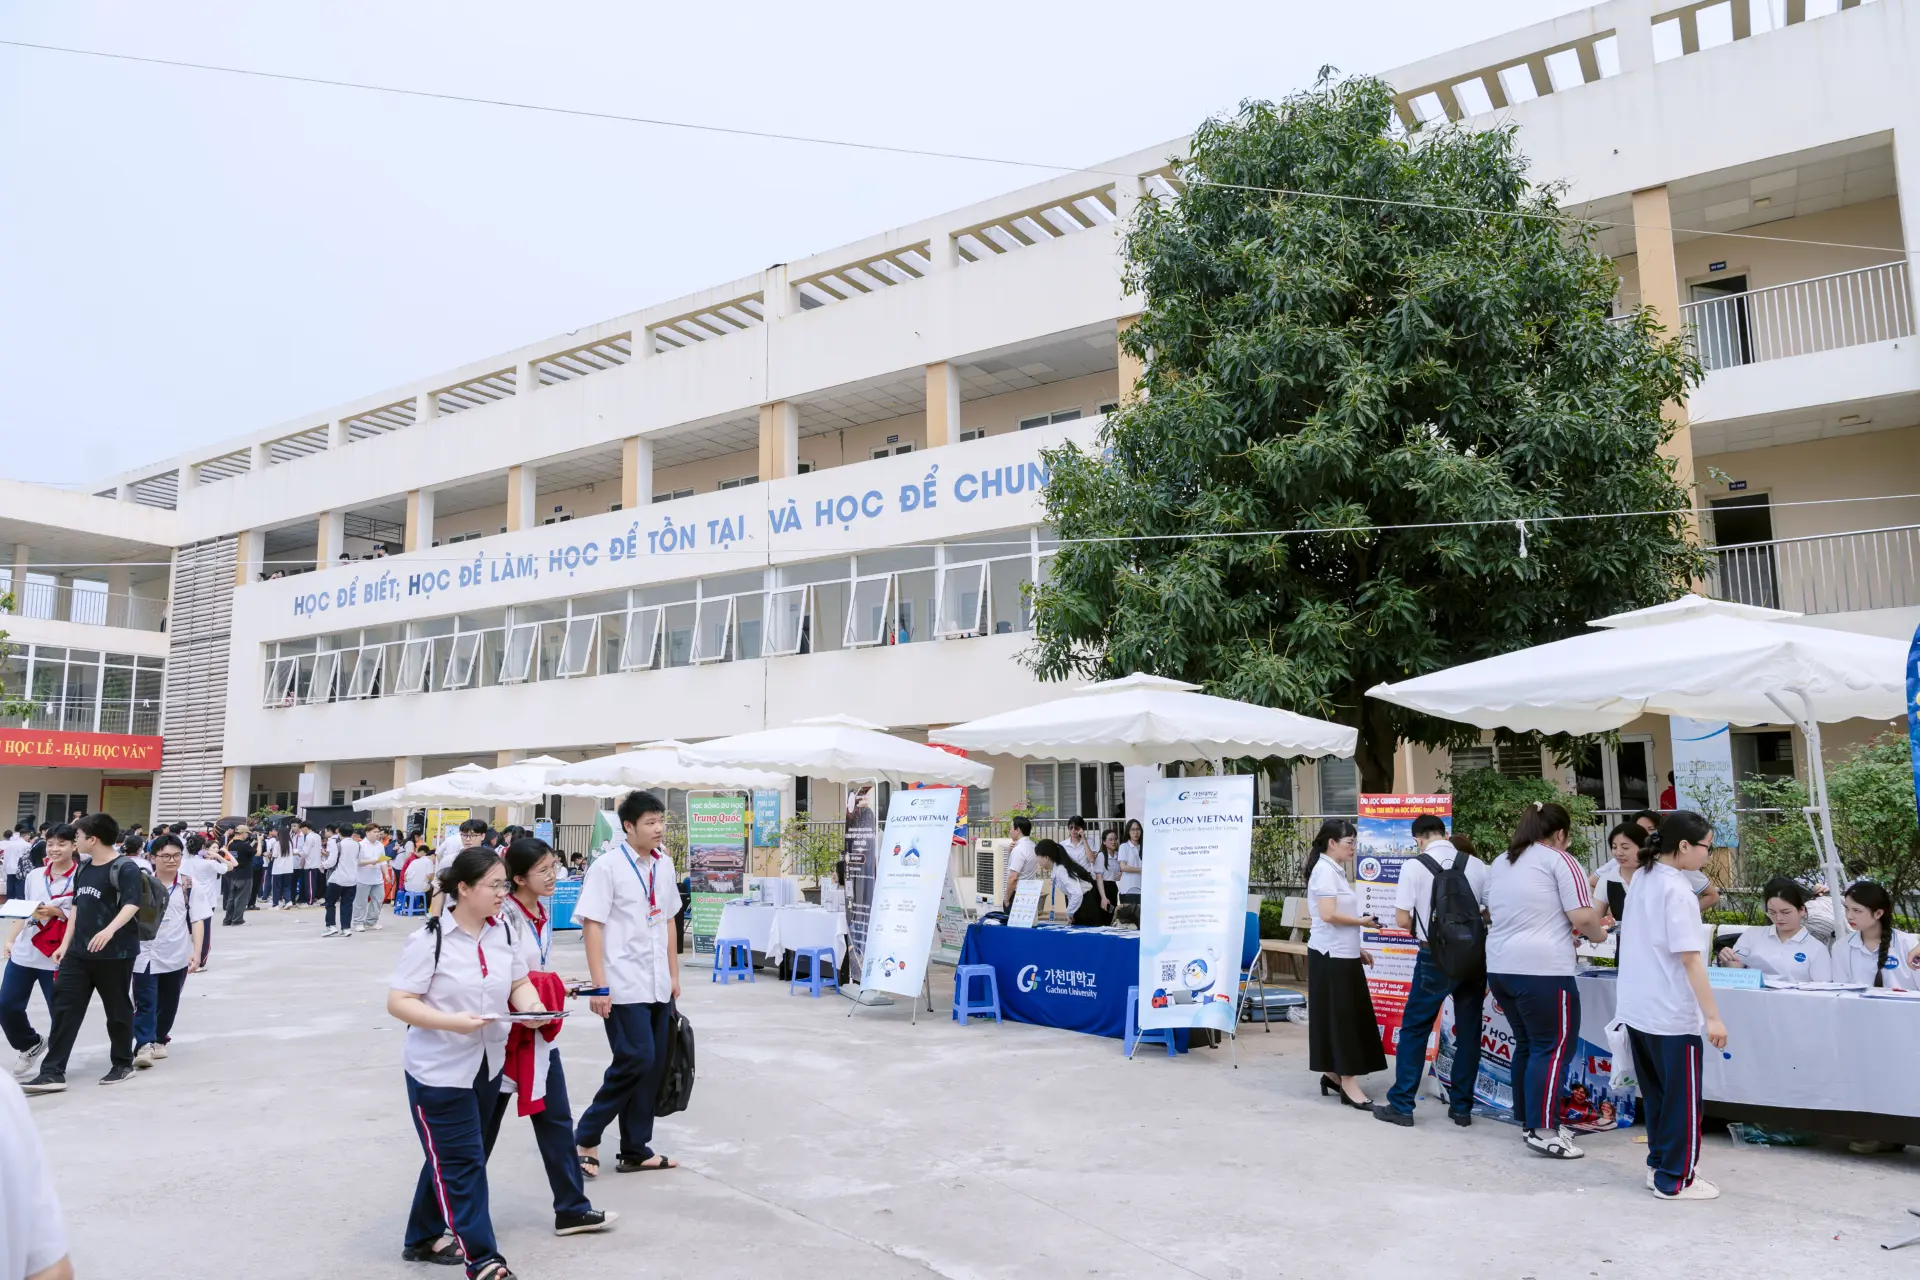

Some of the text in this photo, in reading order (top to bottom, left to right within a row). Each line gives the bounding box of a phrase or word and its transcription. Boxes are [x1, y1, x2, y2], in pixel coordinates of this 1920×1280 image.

[294, 460, 1050, 619] HỌC ĐỂ BIẾT; HỌC ĐỂ LÀM; HỌC ĐỂ TỒN TẠI VÀ HỌC ĐỂ CHUN
[5, 740, 34, 757] HỌC
[64, 741, 90, 759] HẬU
[93, 744, 119, 760] HỌC
[693, 811, 741, 824] Trung Quốc
[1152, 814, 1243, 826] GACHON VIETNAM
[1044, 968, 1097, 988] 가천대학교
[1045, 985, 1097, 999] Gachon University
[1489, 1027, 1516, 1046] HỌC
